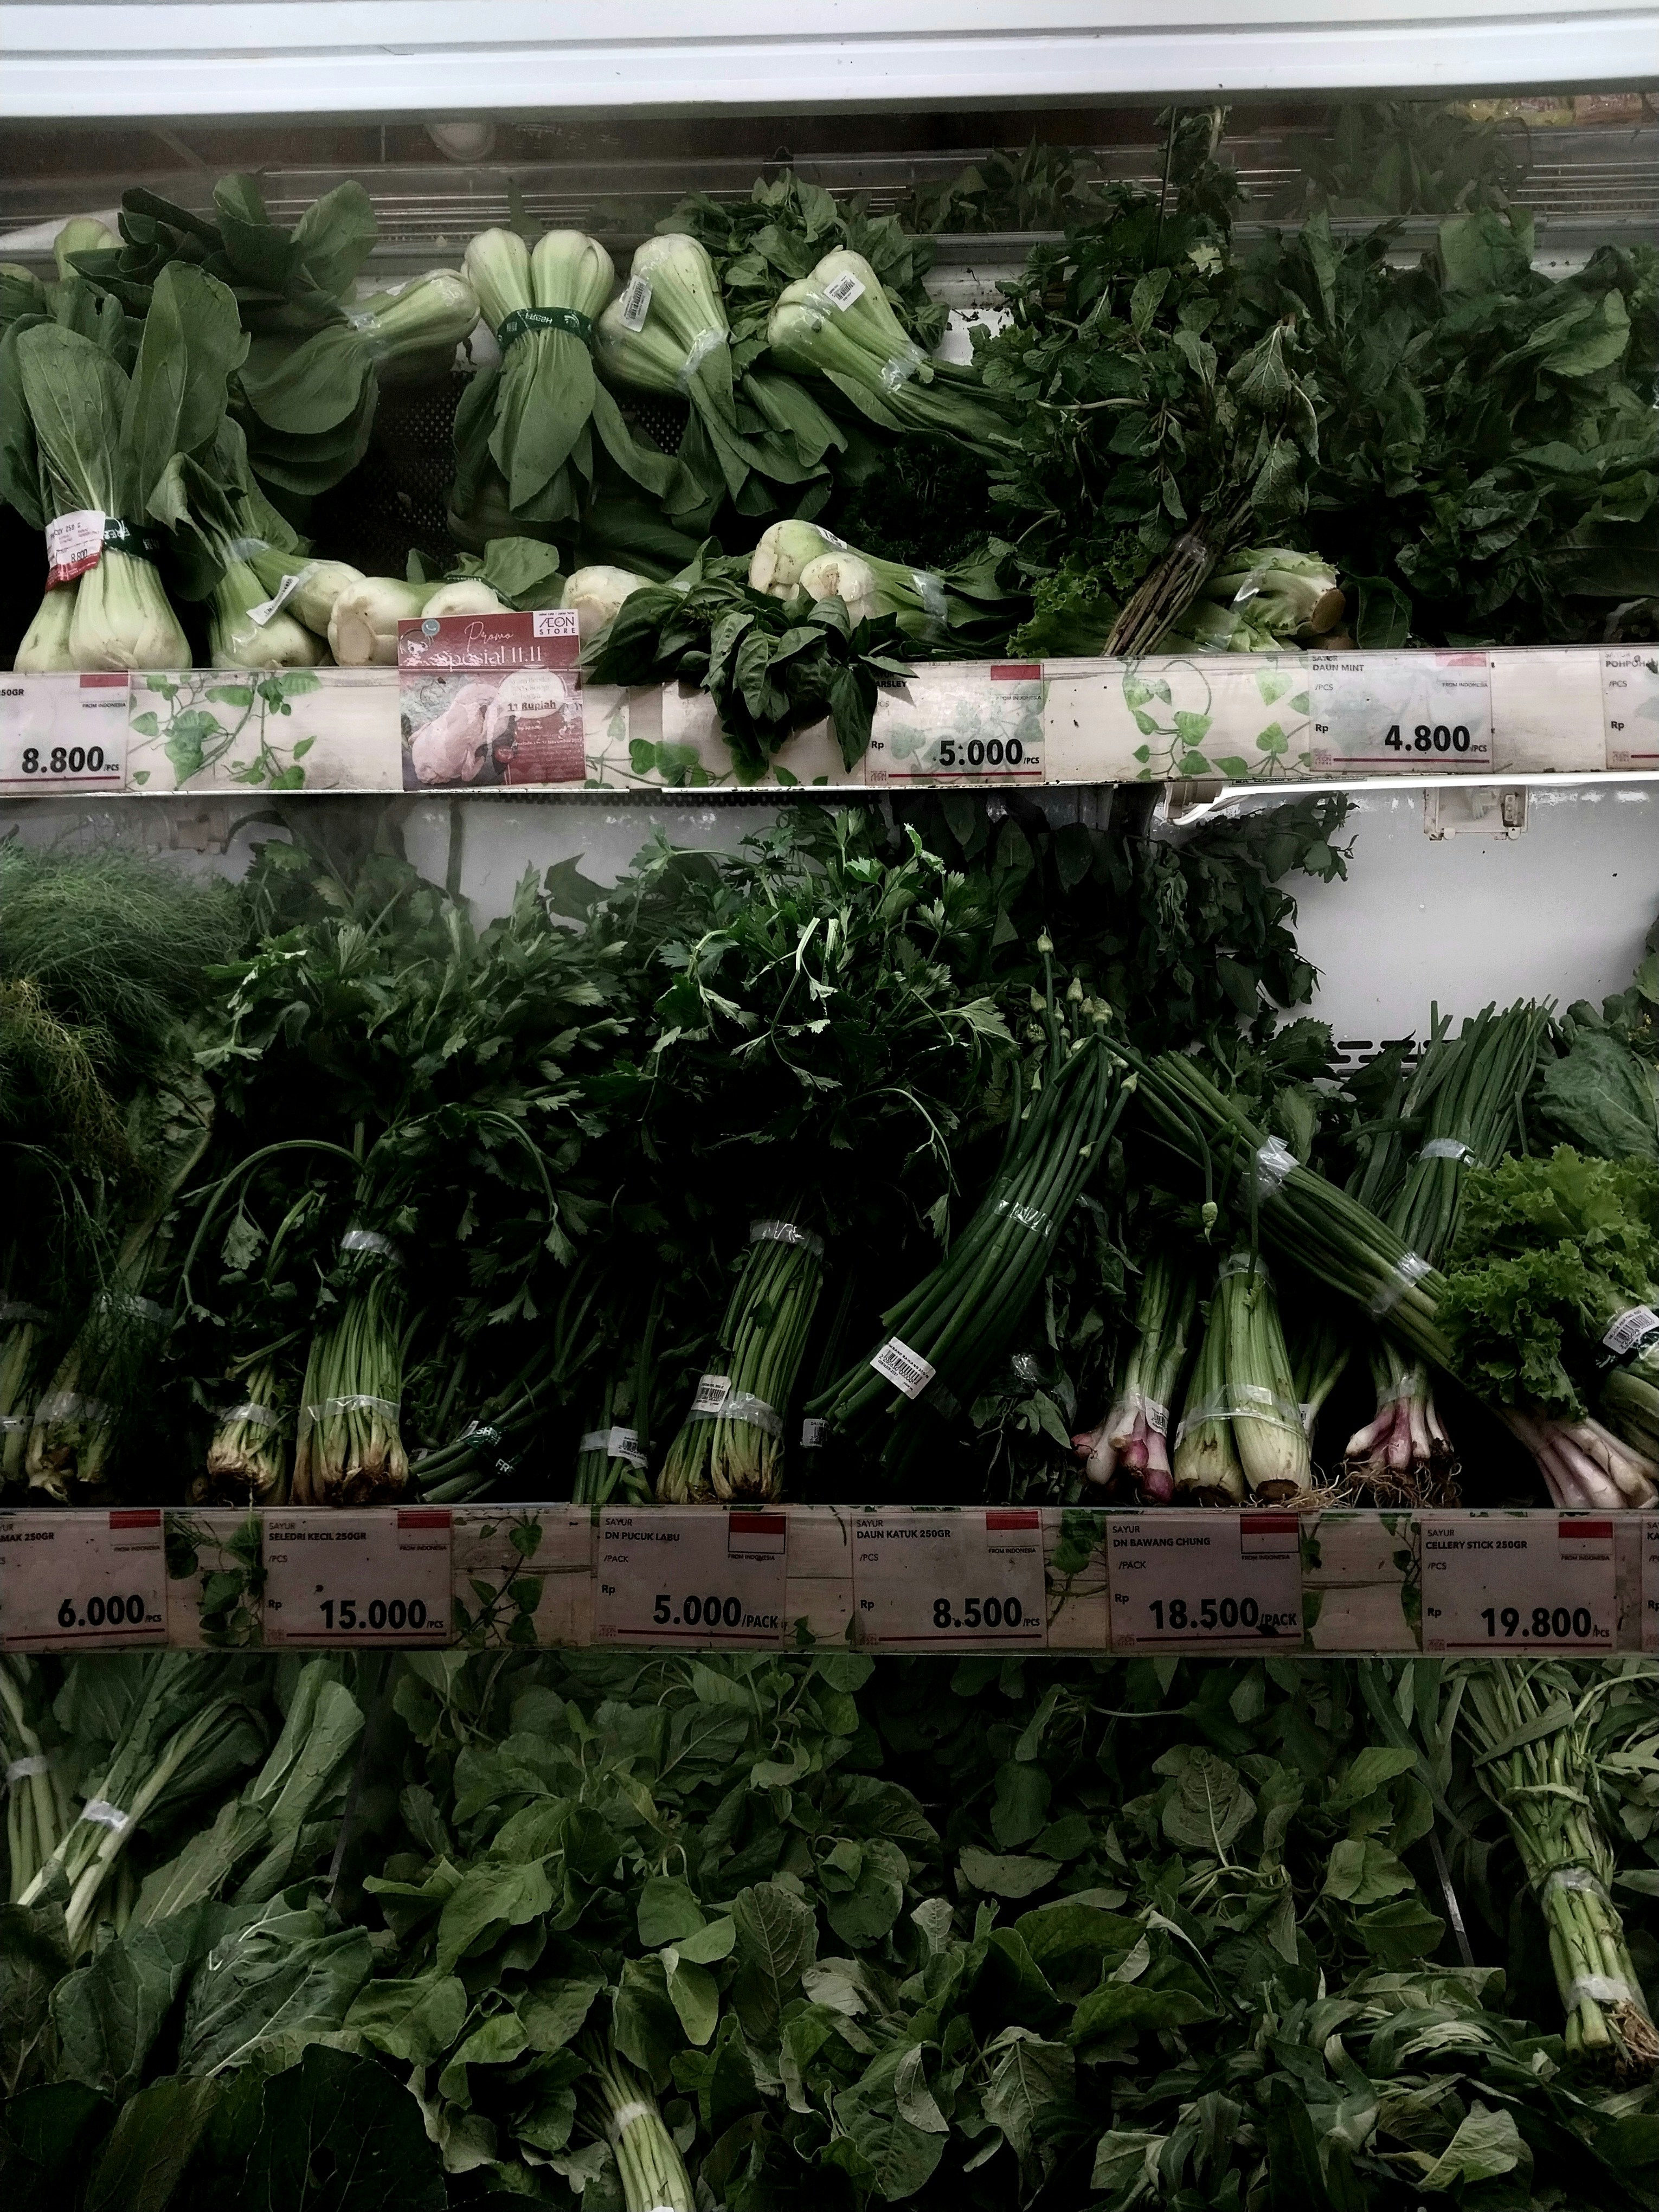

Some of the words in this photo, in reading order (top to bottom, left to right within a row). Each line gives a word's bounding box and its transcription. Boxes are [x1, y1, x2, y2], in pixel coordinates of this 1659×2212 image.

[465, 621, 514, 654] Promo
[522, 700, 556, 711] Rupiah
[1611, 721, 1625, 731] Rp
[1315, 724, 1329, 734] Rp
[1385, 725, 1470, 752] 4.800
[871, 741, 884, 751] Rp
[938, 738, 1024, 766] 5.000
[22, 746, 104, 774] 8.800
[269, 1522, 296, 1531] SAYUR
[605, 1518, 633, 1527] SAYUR
[856, 1520, 884, 1528] SAYUR
[856, 1530, 884, 1539] DAUN
[886, 1529, 918, 1539] KATUK
[919, 1529, 951, 1538] 250GR
[1112, 1526, 1141, 1534] SAYUR
[1427, 1529, 1455, 1538] SAYUR
[24, 1532, 54, 1541] 250GR
[269, 1532, 306, 1541] SELEDRI
[307, 1532, 335, 1541] KECIL
[335, 1532, 367, 1541] 250GR
[605, 1532, 620, 1540] DN
[621, 1532, 654, 1541] PUCUK
[655, 1533, 680, 1541] LABU
[1113, 1539, 1128, 1547] DN
[1130, 1538, 1174, 1547] BAWANG
[1175, 1537, 1211, 1546] CHUNG
[1425, 1541, 1465, 1549] CELLERY
[1467, 1541, 1494, 1549] STICK
[1496, 1541, 1528, 1549] 250GR
[268, 1555, 288, 1563] /PCS
[603, 1555, 629, 1563] /PACK
[859, 1553, 879, 1562] /PCS
[1118, 1561, 1147, 1570] /PACK
[1427, 1562, 1448, 1571] /PCS
[57, 1594, 145, 1628] 6.000
[145, 1614, 162, 1623] /PCS
[601, 1584, 616, 1596] Rp
[653, 1594, 742, 1626] 5.000
[741, 1614, 779, 1629] /PACK
[268, 1599, 282, 1611] Rp
[319, 1599, 427, 1630] 15.000
[426, 1621, 443, 1629] /PCS
[860, 1599, 875, 1611] Rp
[933, 1596, 1023, 1629] 8.500
[1023, 1618, 1041, 1627] /PCS
[1115, 1593, 1130, 1605] Rp
[1148, 1597, 1259, 1630] 18.500
[1259, 1613, 1298, 1626] /PACK
[1427, 1607, 1442, 1619] Rp
[1481, 1607, 1592, 1638] 19.800
[1592, 1628, 1610, 1638] /PCS
